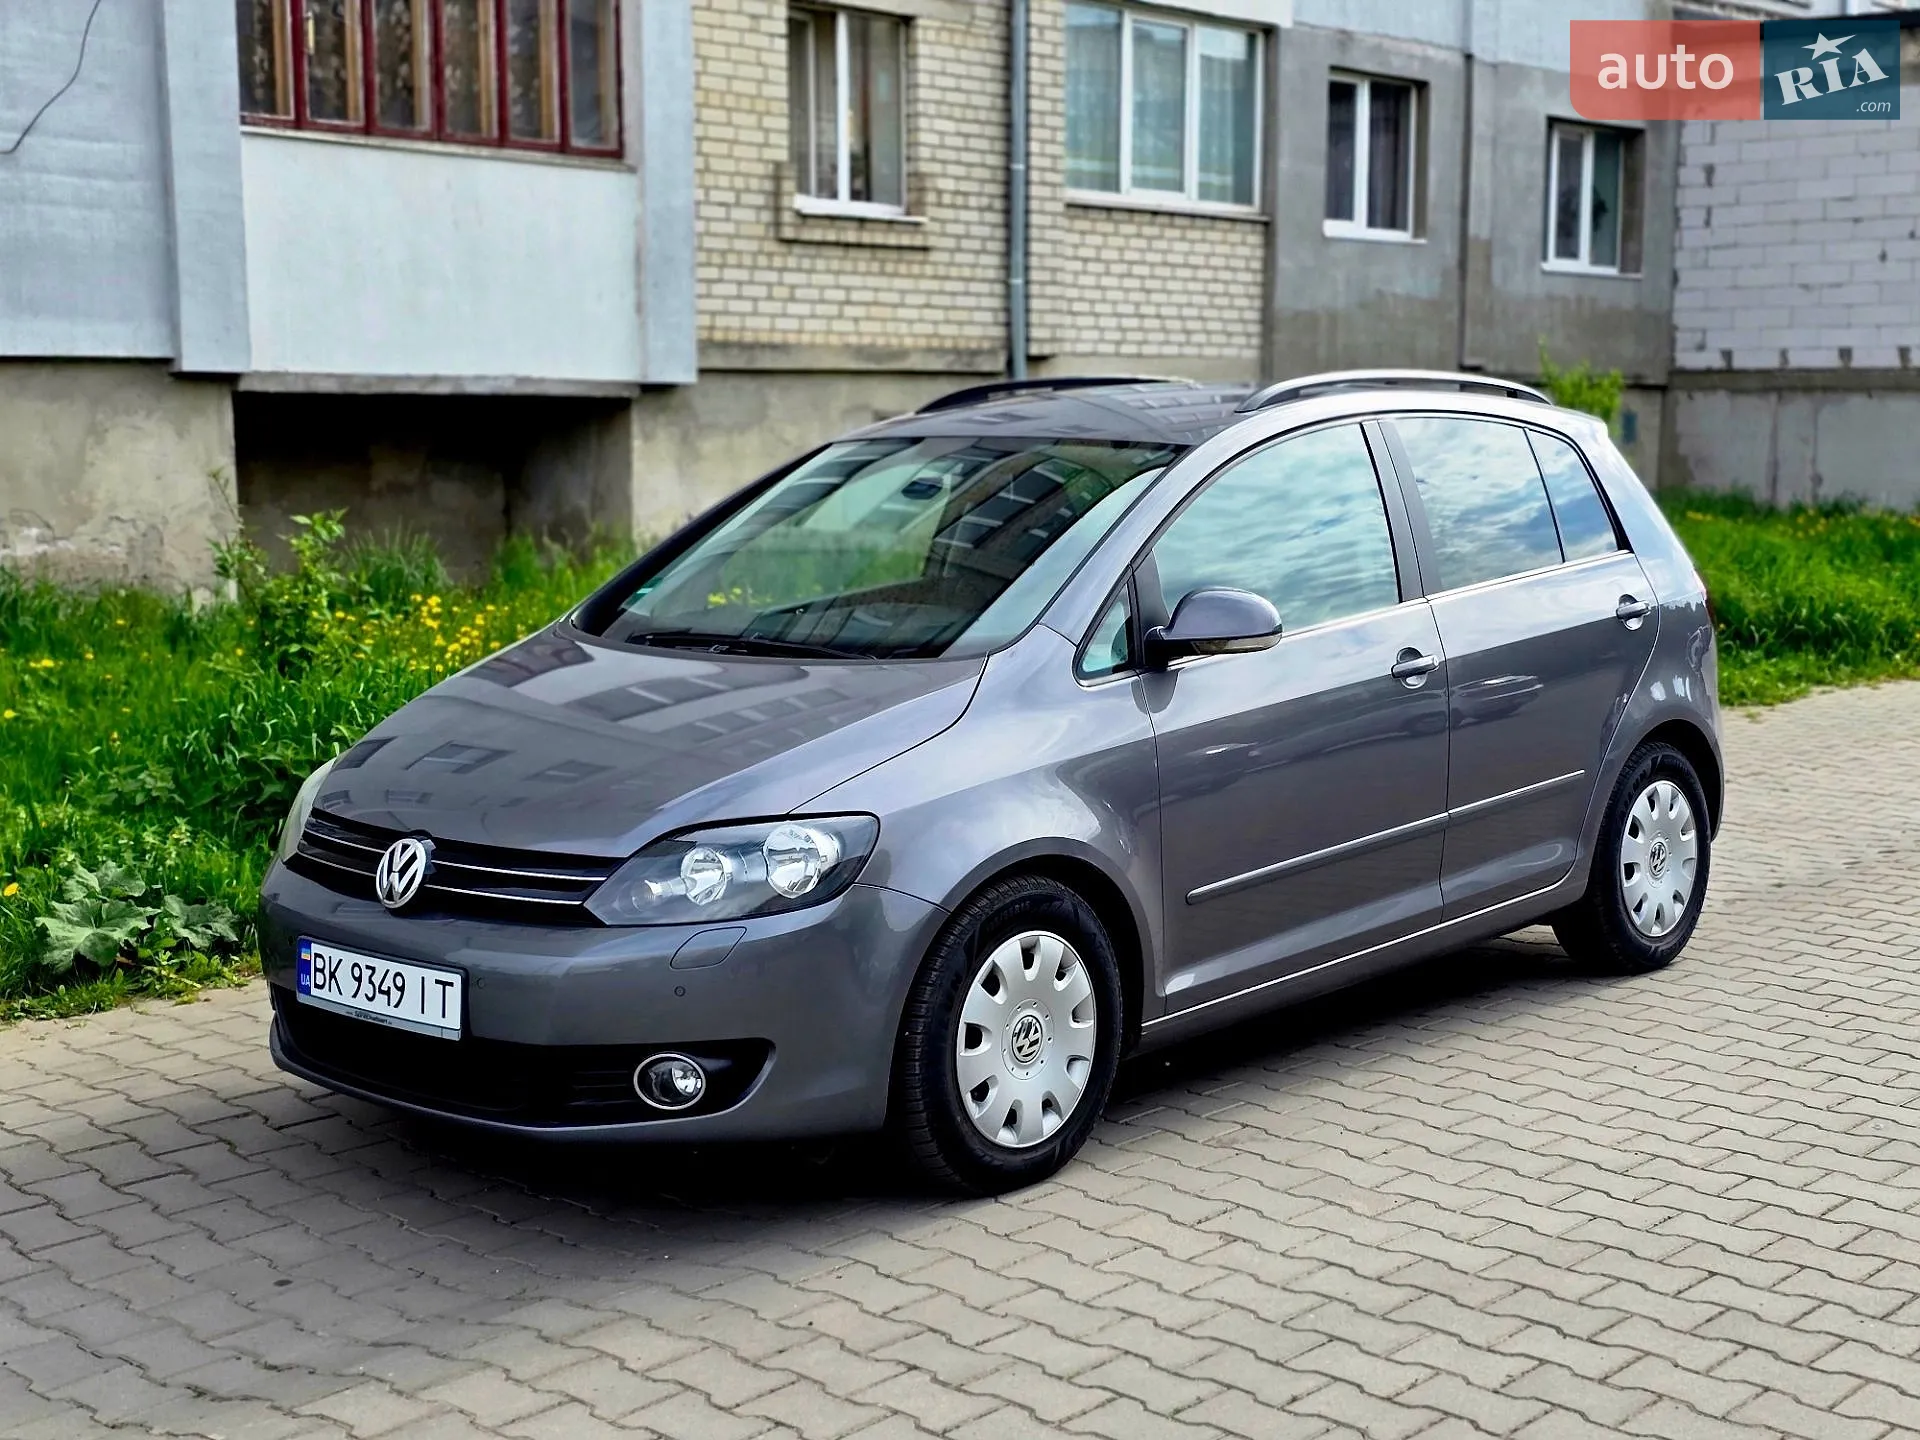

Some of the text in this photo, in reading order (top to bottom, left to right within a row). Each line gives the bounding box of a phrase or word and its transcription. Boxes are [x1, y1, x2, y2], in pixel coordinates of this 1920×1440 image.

[301, 973, 311, 987] UA
[313, 952, 454, 1019] BK 9349 IT
